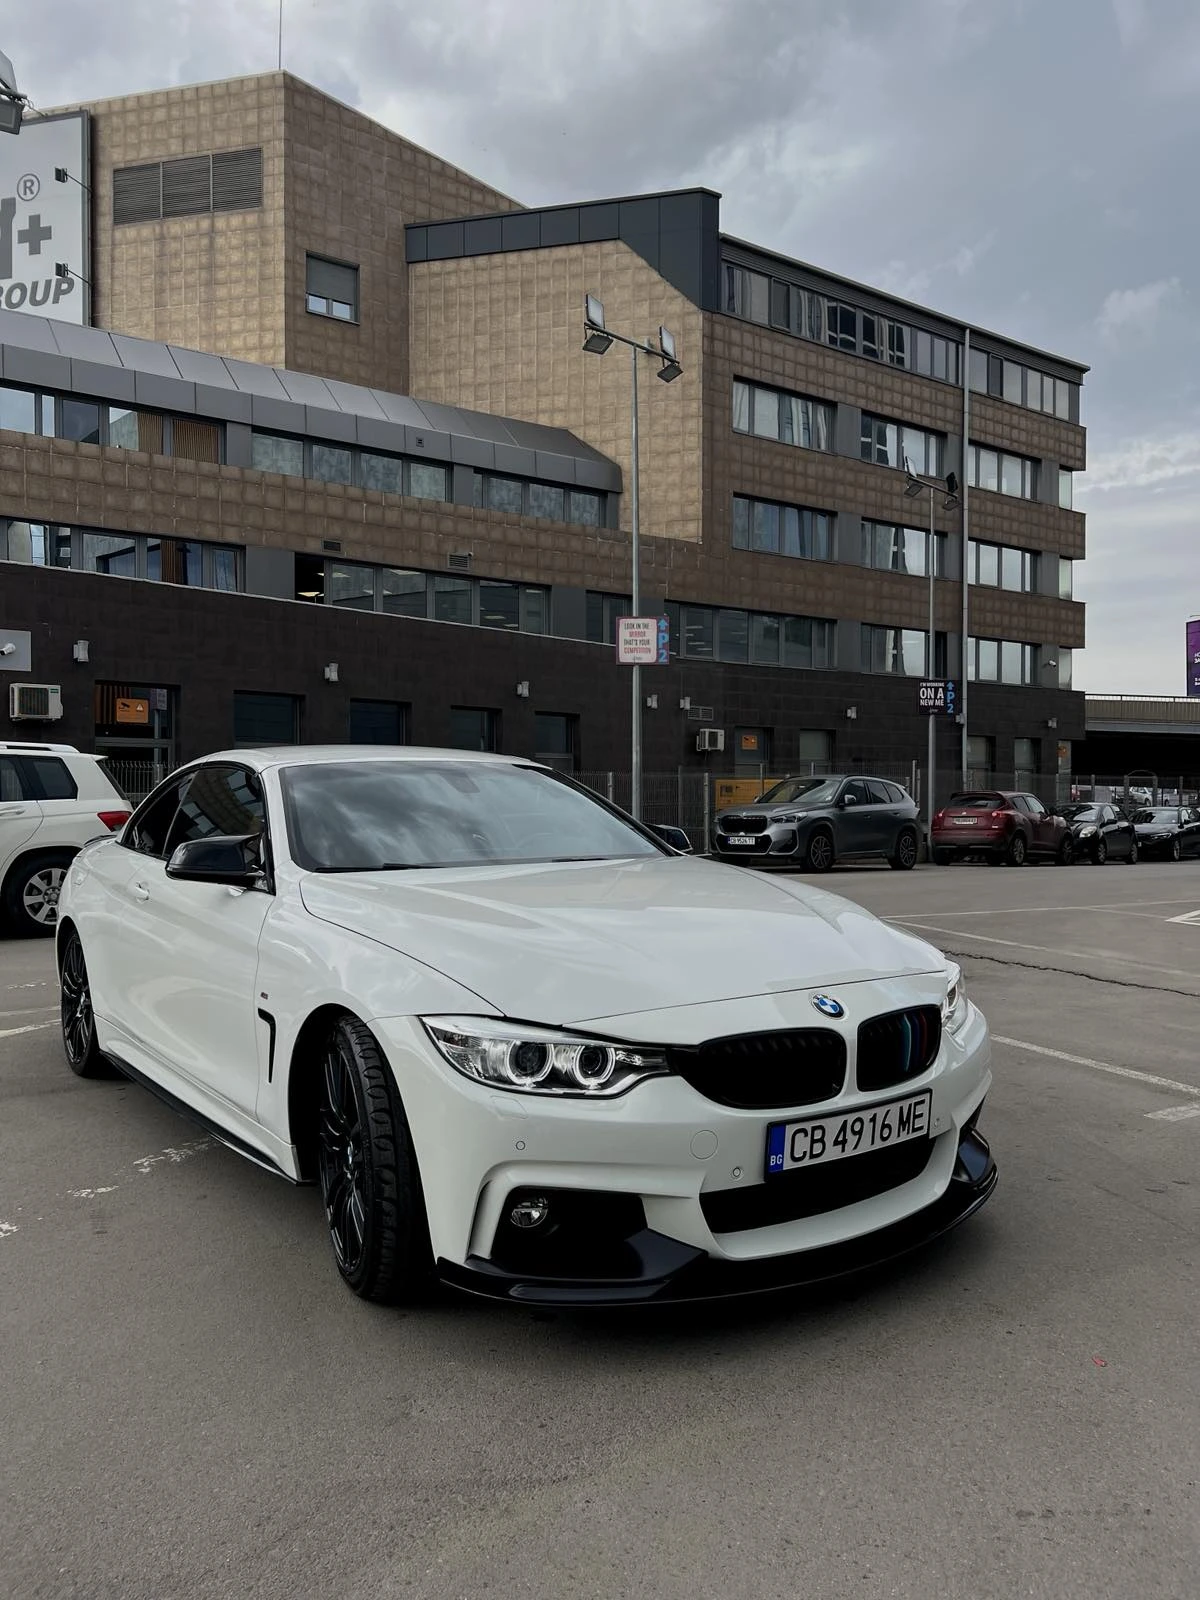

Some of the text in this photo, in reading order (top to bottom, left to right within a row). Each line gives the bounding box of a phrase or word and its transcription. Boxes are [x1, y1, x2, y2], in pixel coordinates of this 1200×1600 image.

[0, 277, 75, 309] OUP
[920, 688, 944, 699] ON A
[790, 1099, 926, 1163] CB 4916 ME
[770, 1154, 783, 1166] BG
